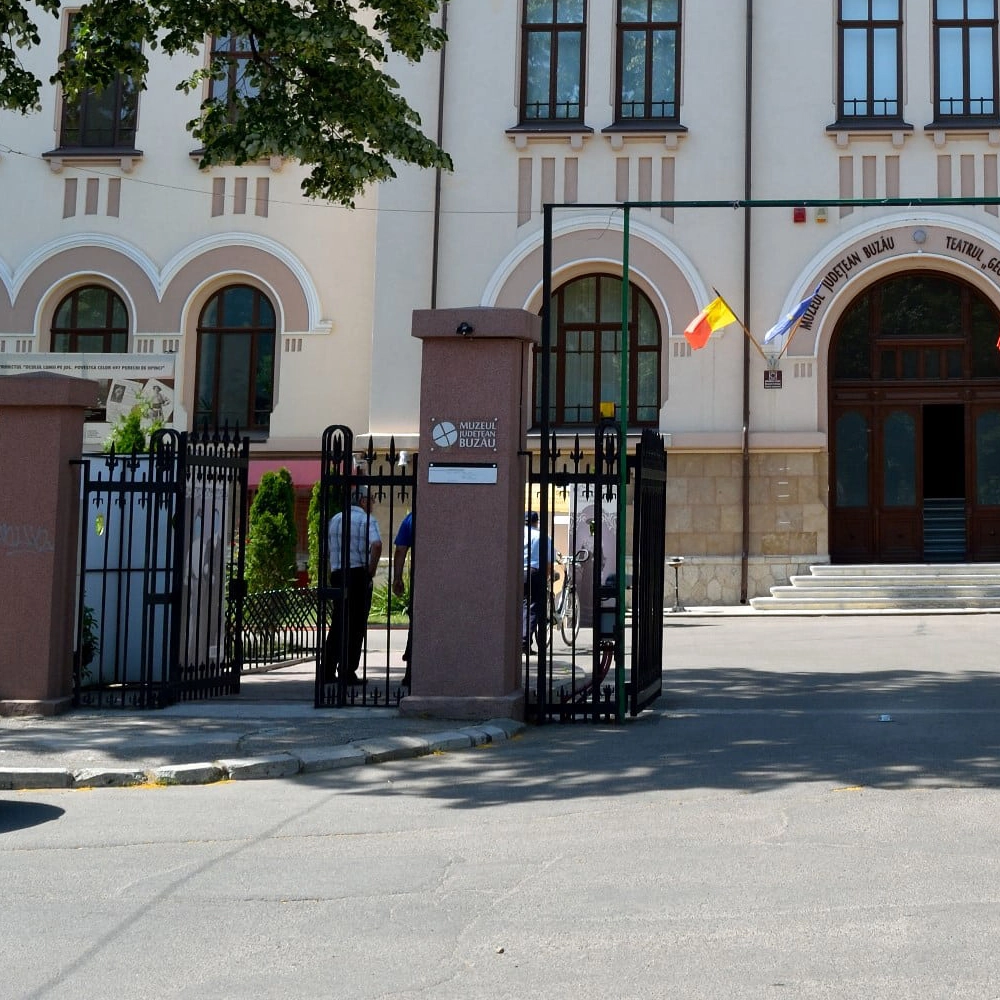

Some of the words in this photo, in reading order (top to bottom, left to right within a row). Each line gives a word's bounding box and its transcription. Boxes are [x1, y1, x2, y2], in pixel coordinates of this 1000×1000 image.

[946, 236, 984, 262] TEATRUL
[800, 293, 826, 331] MUZEUL
[821, 251, 862, 293] JUDEȚEAN
[863, 236, 895, 259] BUZĂU
[459, 421, 497, 430] MUZEUL
